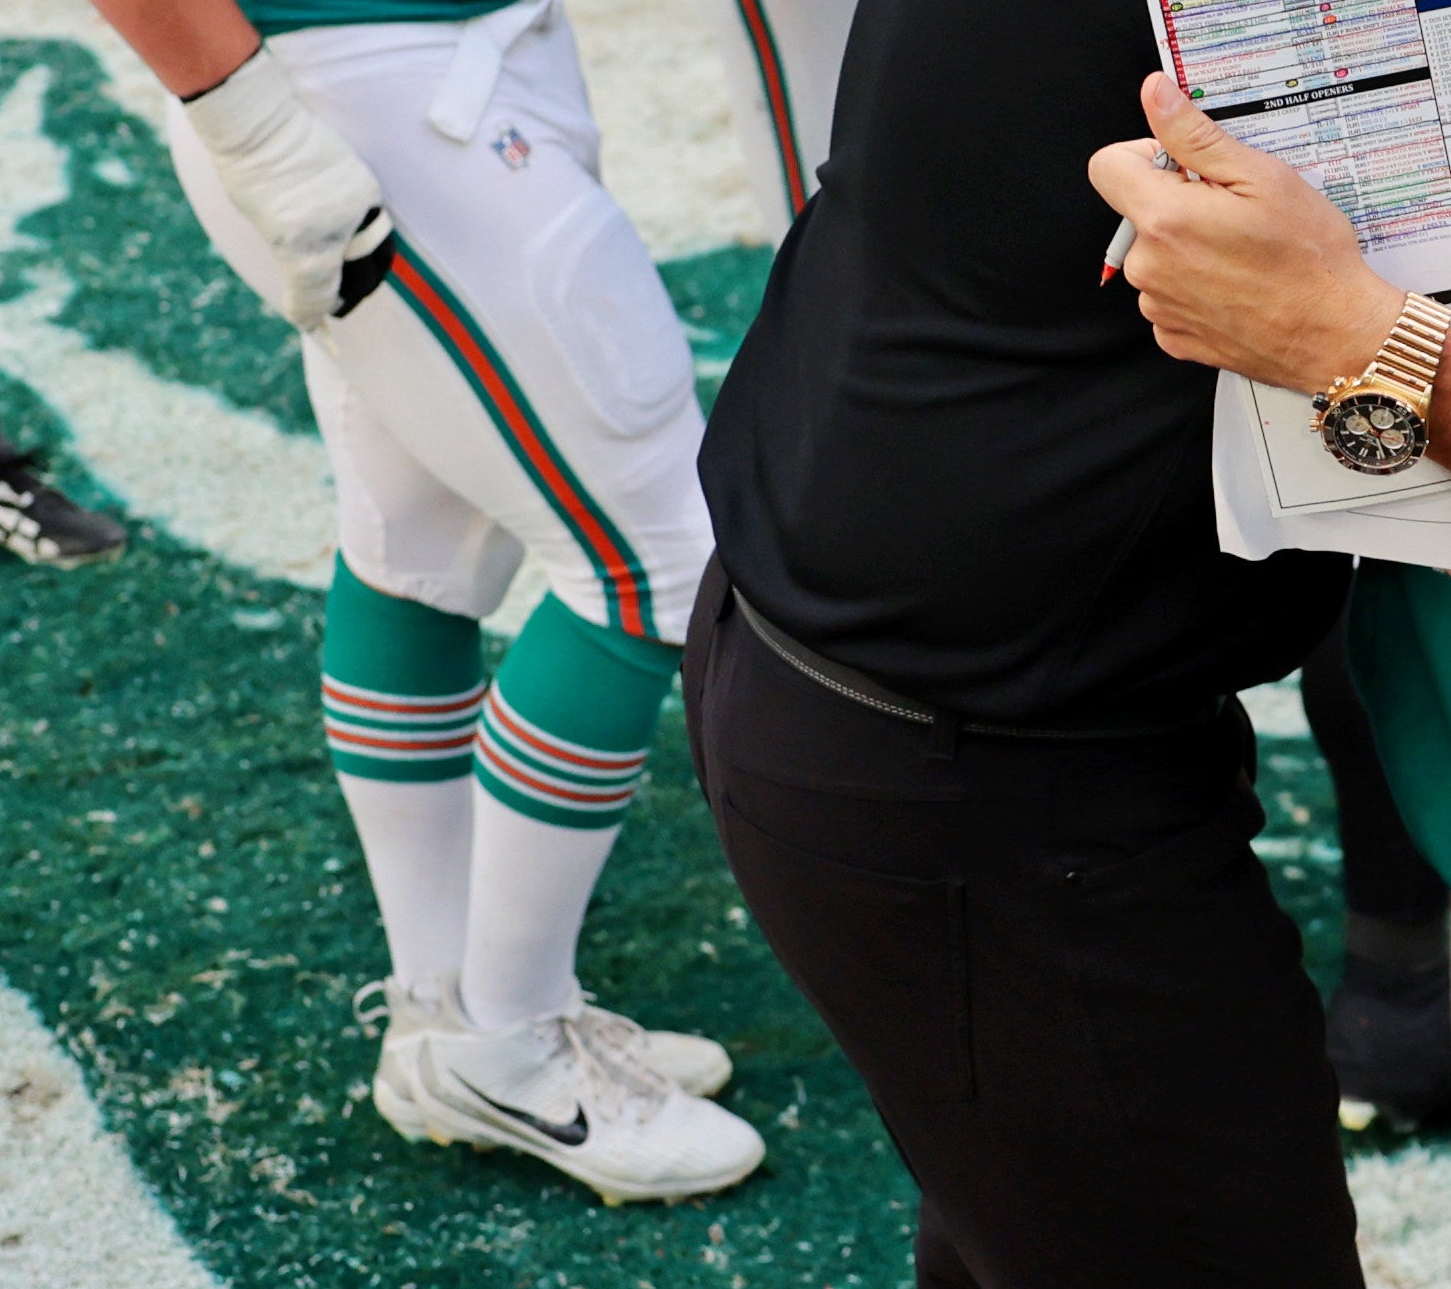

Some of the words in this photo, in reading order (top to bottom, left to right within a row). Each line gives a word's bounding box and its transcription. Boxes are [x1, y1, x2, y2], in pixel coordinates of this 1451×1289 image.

[1263, 98, 1283, 109] 2ND
[1285, 93, 1309, 104] HALF
[1310, 84, 1354, 99] OPENERS
